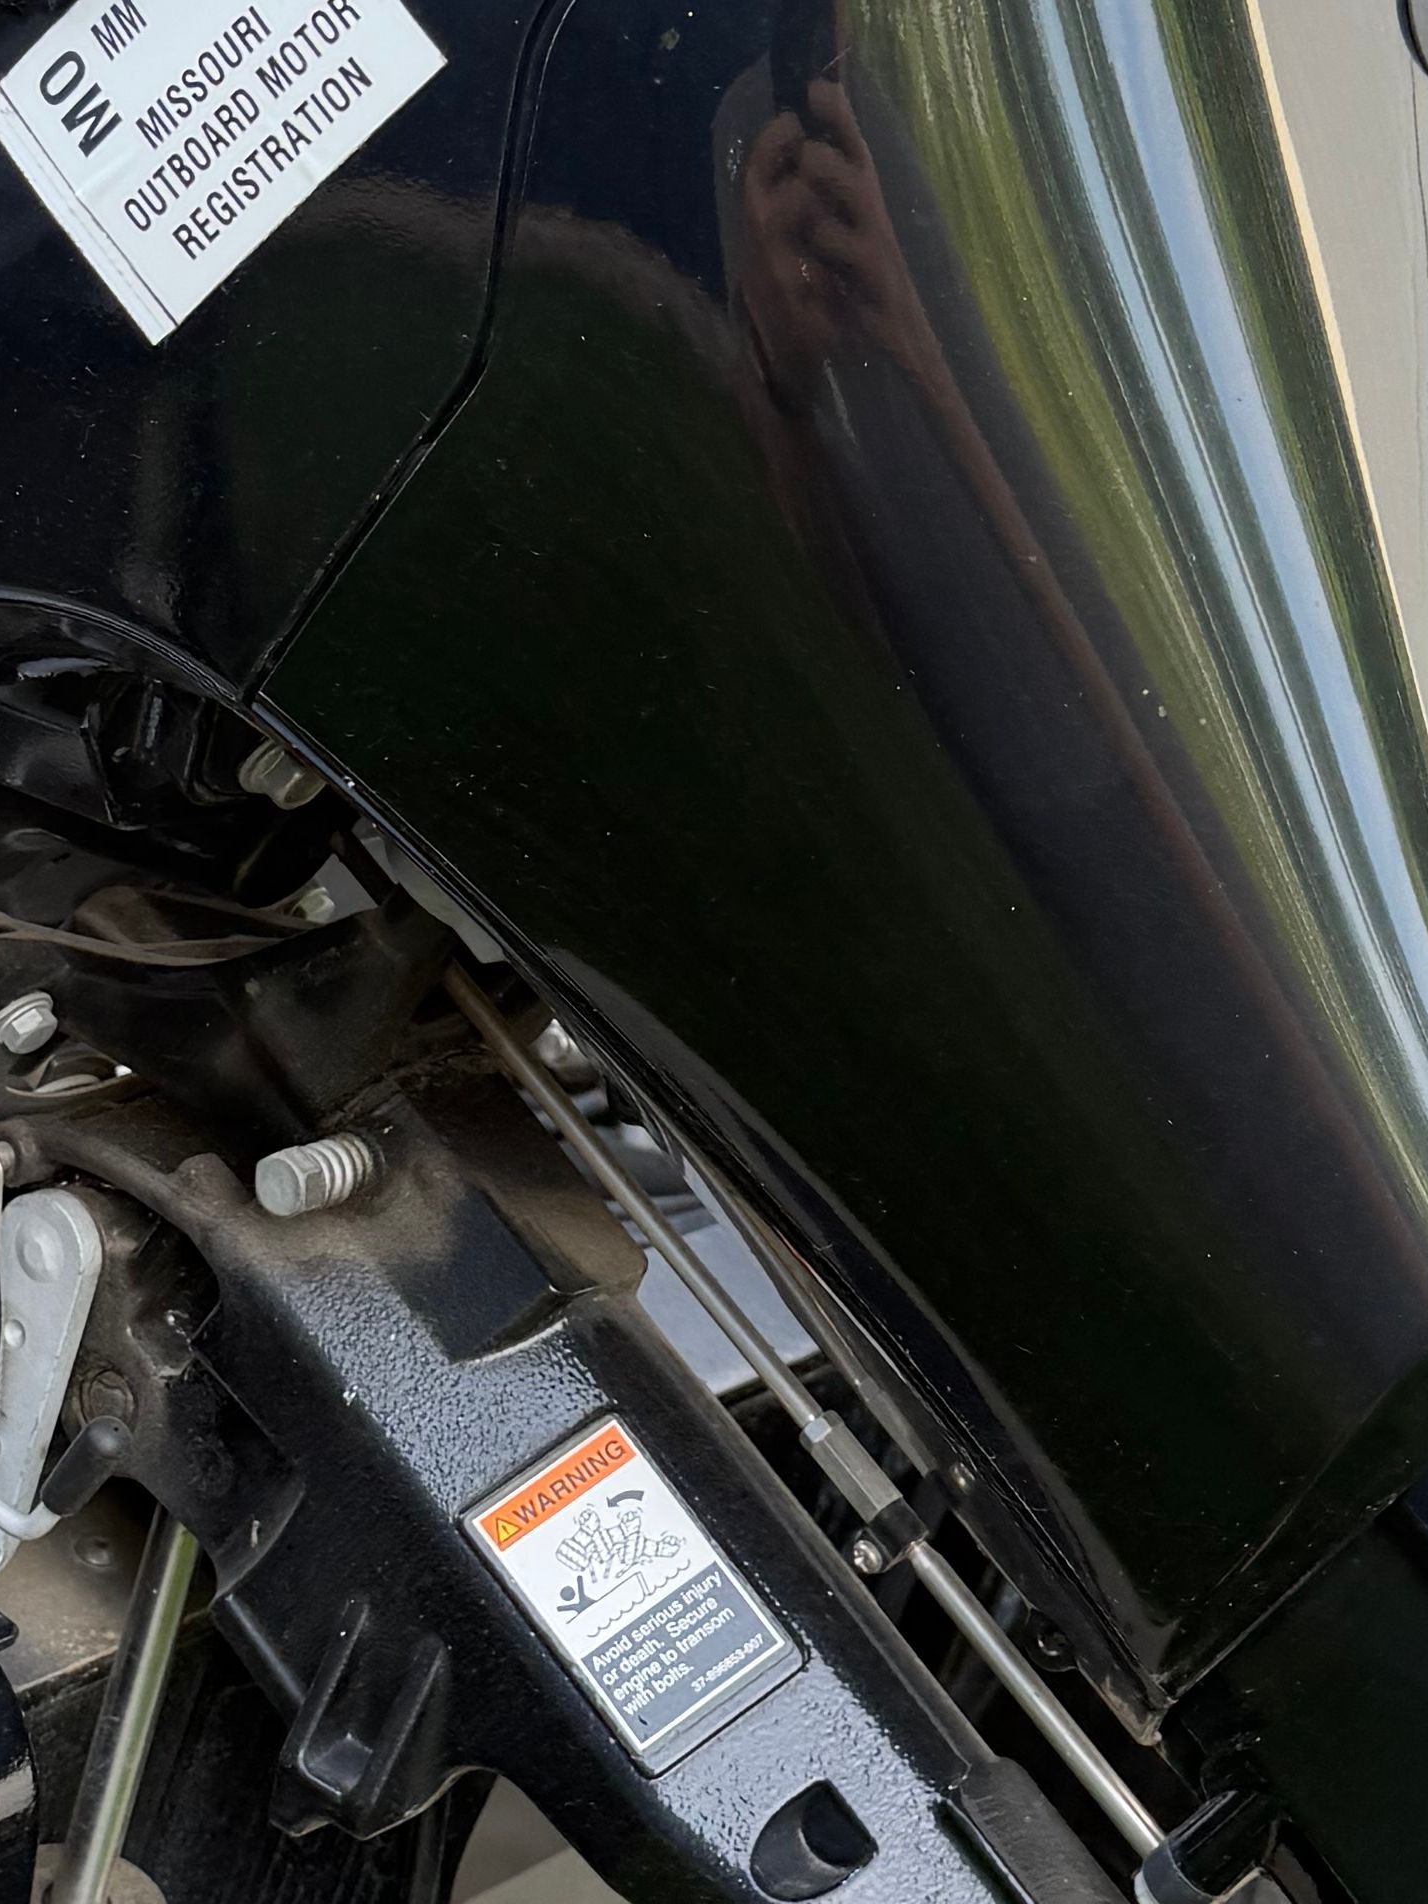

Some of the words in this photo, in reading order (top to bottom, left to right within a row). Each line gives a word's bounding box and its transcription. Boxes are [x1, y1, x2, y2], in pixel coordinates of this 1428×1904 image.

[38, 50, 122, 158] MO
[135, 6, 272, 150] MISSOURI
[124, 87, 260, 231] OUTBOARD
[172, 57, 373, 260] REGISTRATION
[512, 1439, 626, 1525] WARNING
[592, 1635, 632, 1672] Avoid
[631, 1600, 683, 1642] serious
[681, 1571, 722, 1604] injury
[602, 1668, 619, 1685] or
[619, 1637, 665, 1673] death.
[665, 1597, 718, 1638] Secure
[613, 1661, 661, 1701] engine
[659, 1649, 678, 1665] to
[675, 1607, 735, 1654] transom
[623, 1687, 655, 1715] with
[651, 1662, 694, 1693] bolts.
